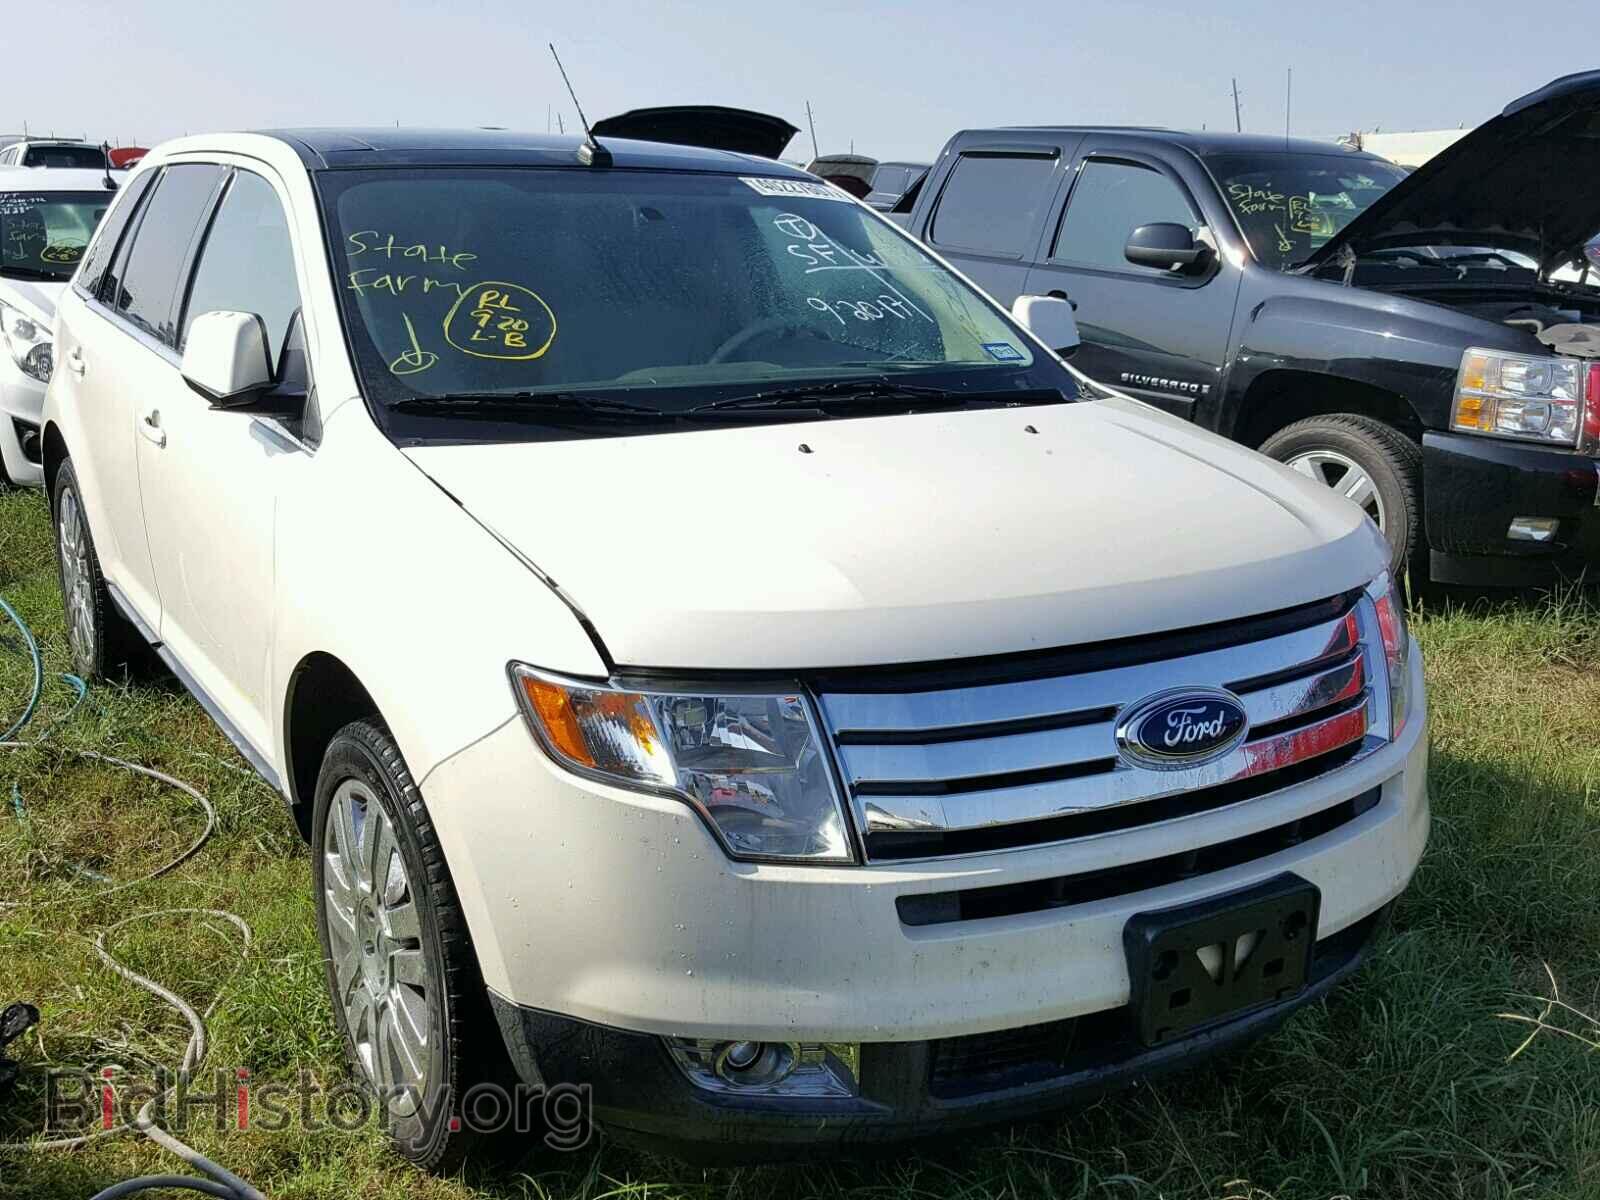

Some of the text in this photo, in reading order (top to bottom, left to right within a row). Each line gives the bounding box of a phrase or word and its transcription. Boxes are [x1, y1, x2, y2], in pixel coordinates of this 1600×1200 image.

[347, 230, 478, 271] State
[347, 267, 465, 297] Farm
[478, 290, 521, 311] RL
[1121, 372, 1200, 393] SILVERADO
[1164, 705, 1226, 748] Ford
